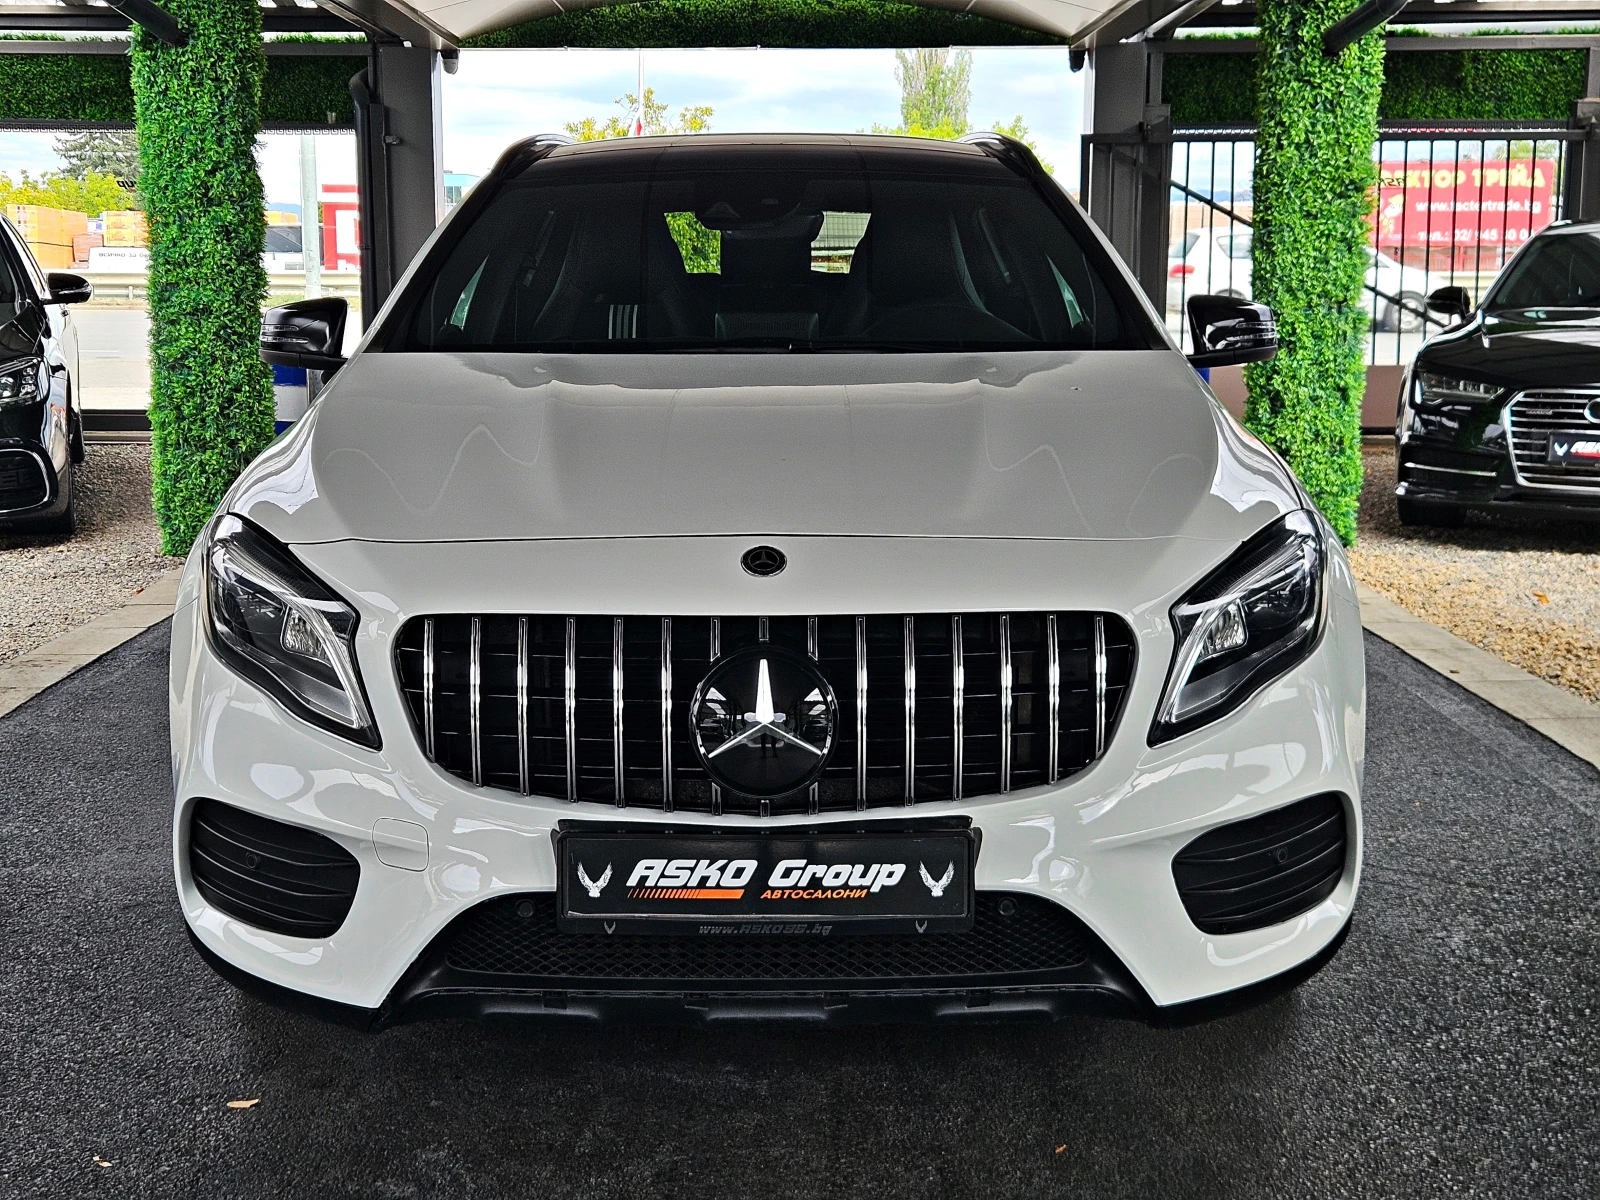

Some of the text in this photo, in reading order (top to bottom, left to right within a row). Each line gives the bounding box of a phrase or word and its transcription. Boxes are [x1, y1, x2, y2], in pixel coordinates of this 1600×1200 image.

[626, 859, 907, 893] ASKO Group
[760, 888, 868, 899] АВТОСАЛОНИ
